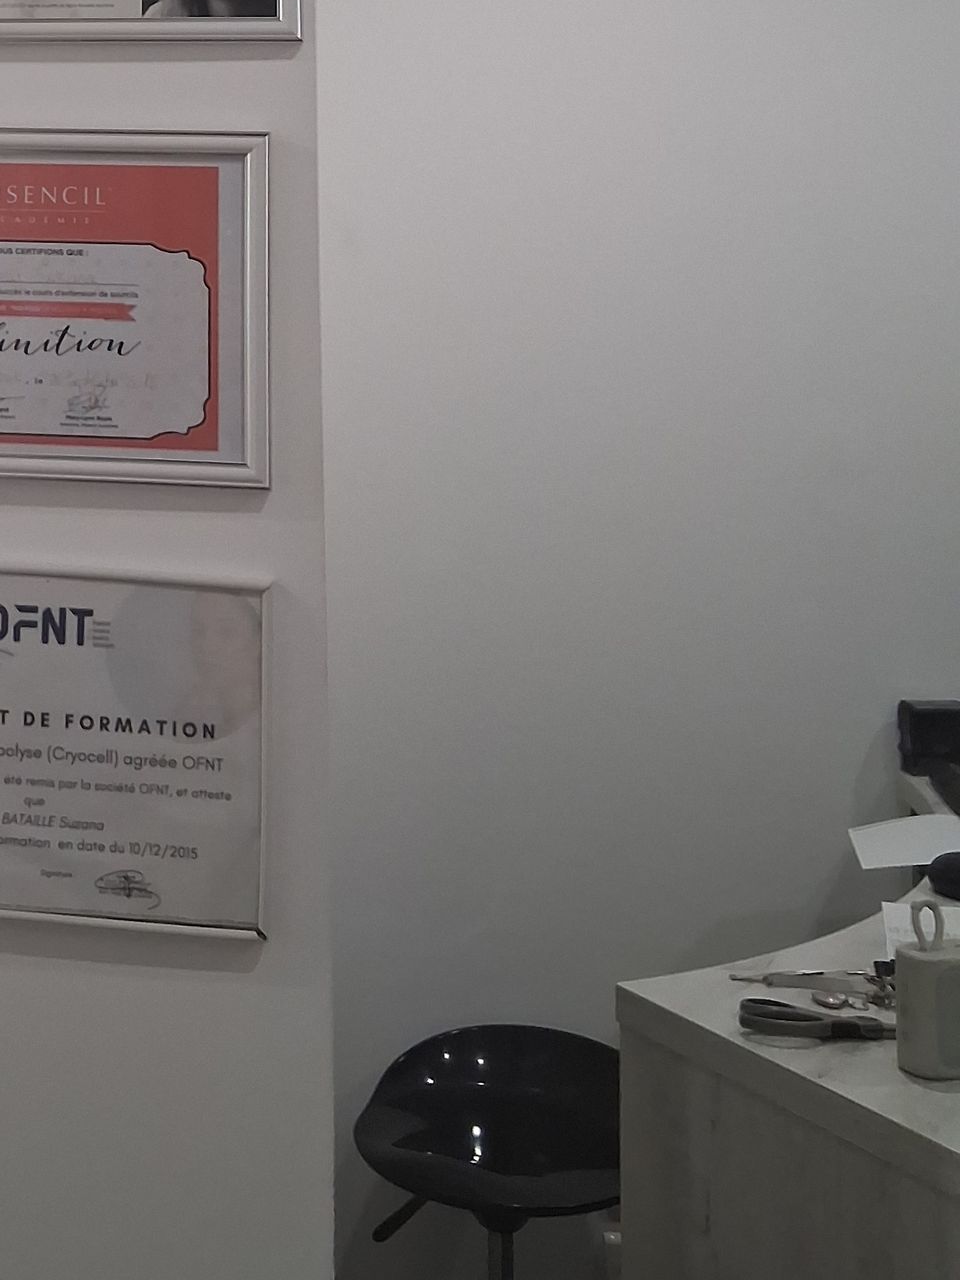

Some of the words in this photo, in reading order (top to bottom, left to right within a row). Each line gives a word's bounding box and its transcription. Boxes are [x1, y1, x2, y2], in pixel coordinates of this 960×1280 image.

[14, 247, 65, 257] CERTIFIONS
[65, 248, 84, 257] QUE
[23, 710, 51, 729] DE
[64, 713, 216, 740] FORMATION
[47, 745, 119, 770] (Cryocell)
[182, 755, 223, 773] OFNT
[25, 777, 55, 789] remis
[58, 779, 78, 792] par
[80, 778, 92, 791] la
[175, 786, 188, 798] et
[190, 787, 232, 802] atteste
[23, 796, 45, 809] que
[1, 812, 56, 829] BATAILLE
[57, 840, 74, 851] en
[76, 837, 106, 854] date
[108, 840, 125, 855] du
[129, 841, 198, 860] 10/12/2015
